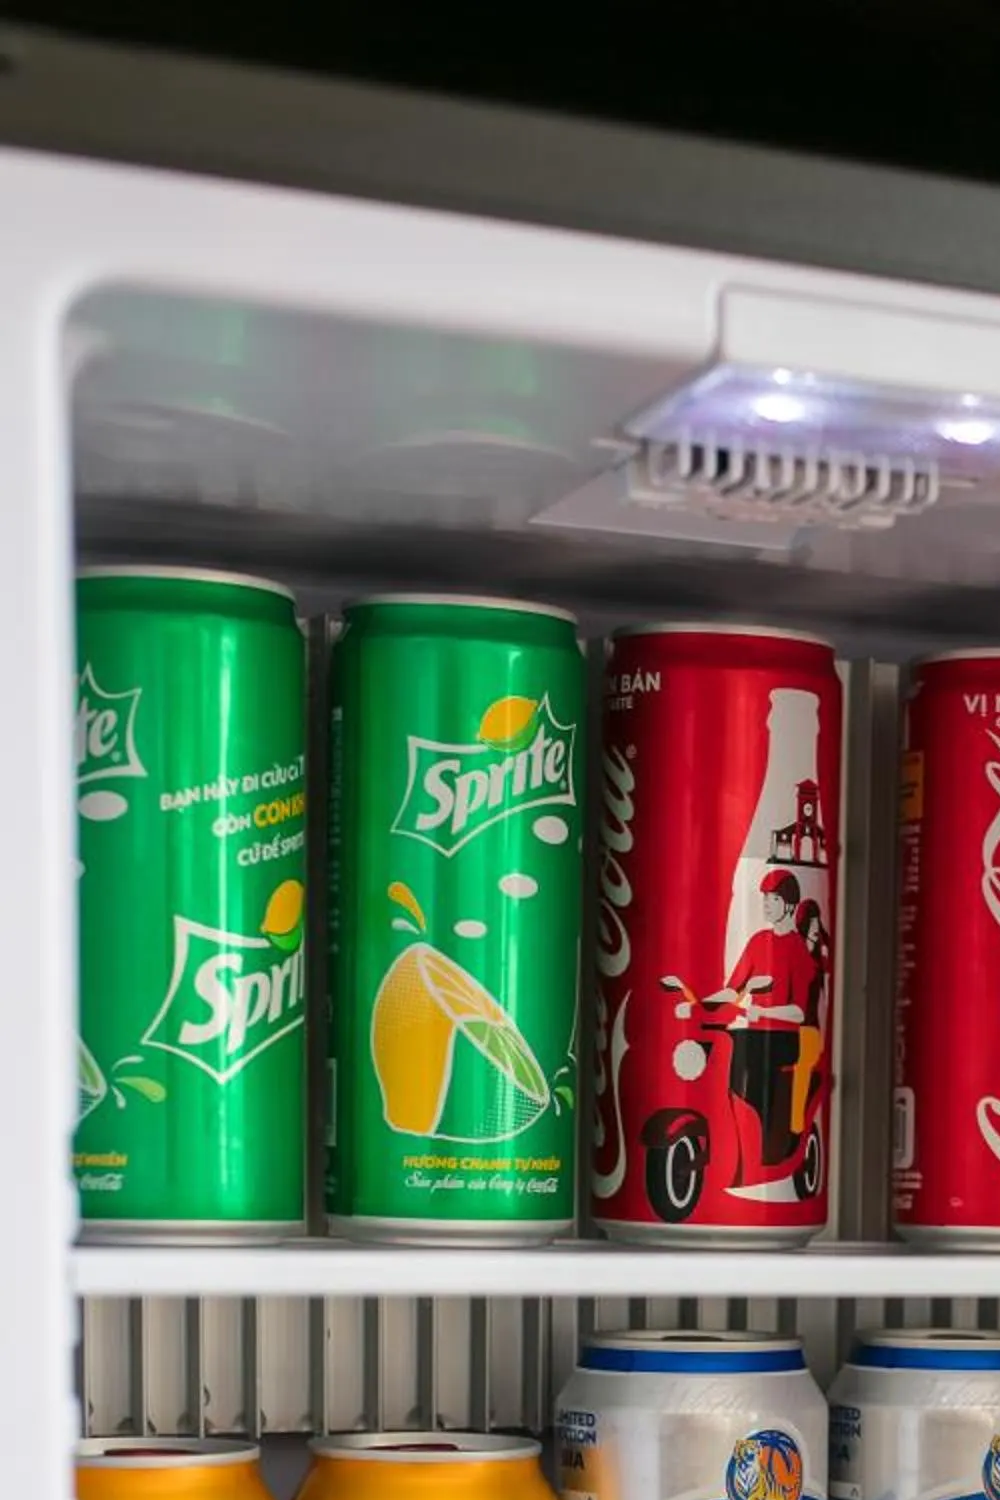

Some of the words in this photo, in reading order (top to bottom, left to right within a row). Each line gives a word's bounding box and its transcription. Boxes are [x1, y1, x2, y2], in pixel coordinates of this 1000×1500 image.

[963, 694, 988, 717] VỊ
[415, 724, 565, 835] Sprite
[178, 930, 304, 1055] Spri
